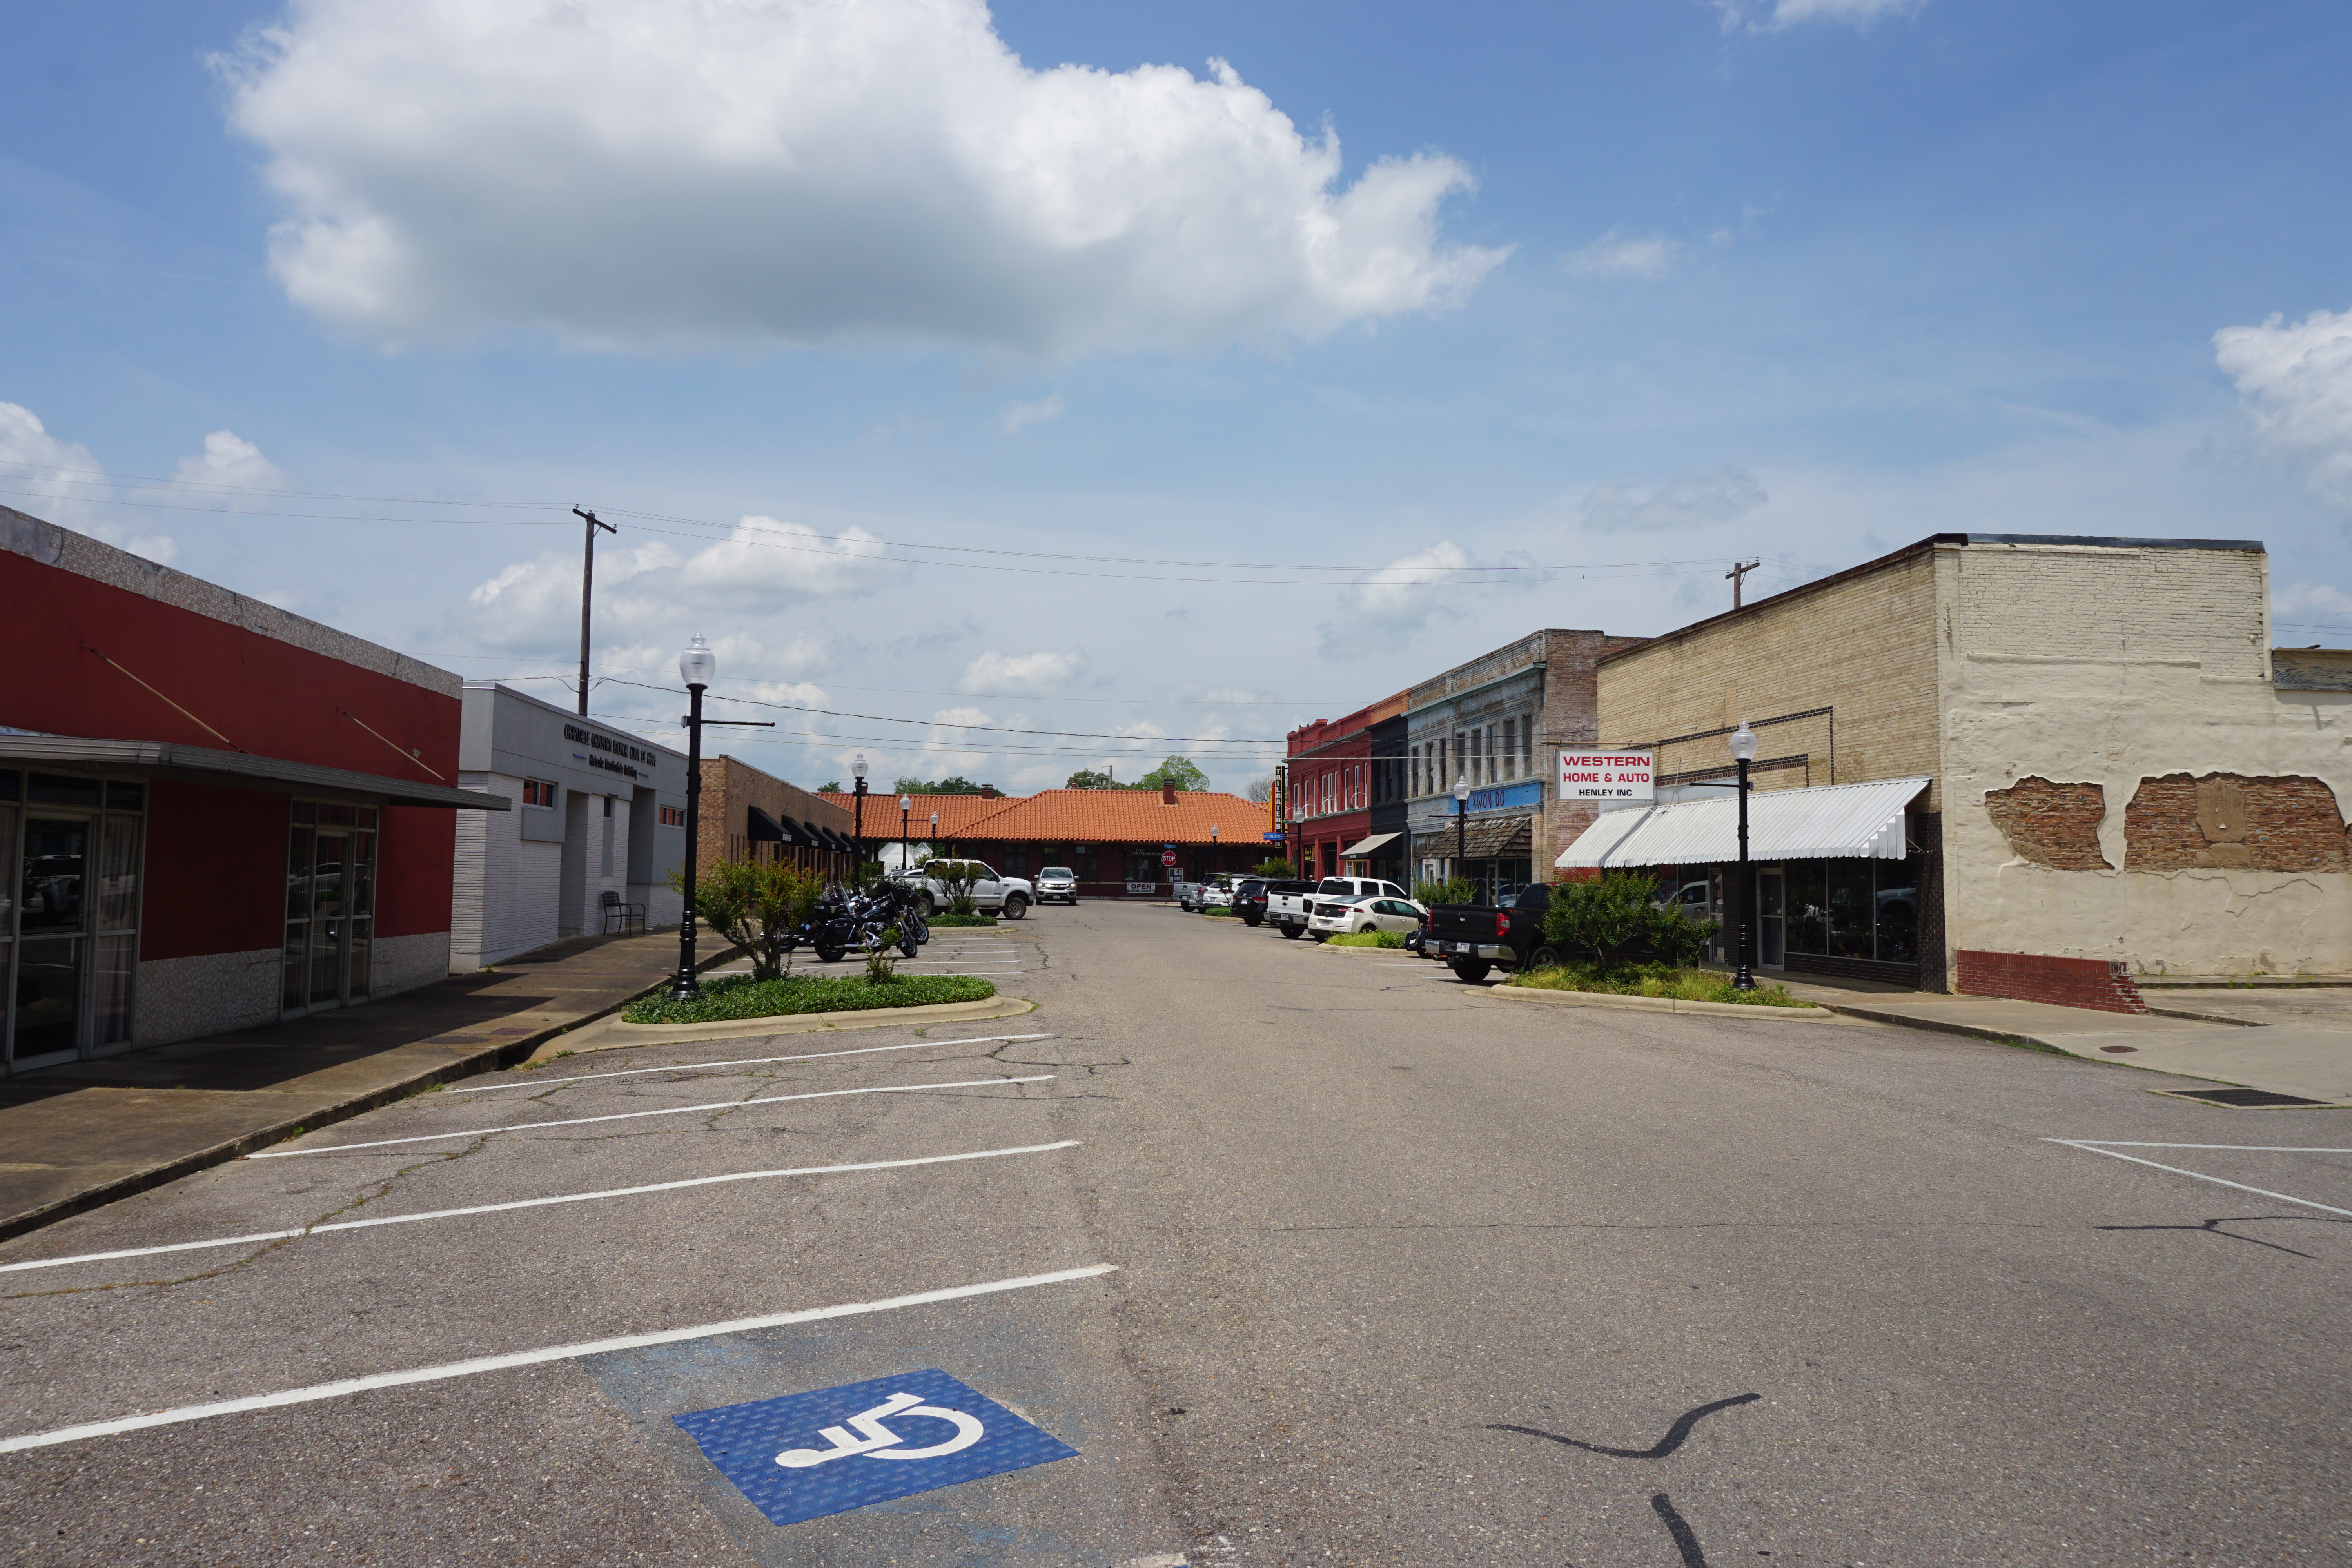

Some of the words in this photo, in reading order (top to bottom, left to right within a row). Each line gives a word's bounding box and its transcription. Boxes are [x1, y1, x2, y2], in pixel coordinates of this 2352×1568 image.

[564, 724, 590, 745] CHARITABLE
[591, 733, 612, 752] CHRISTIAN
[613, 740, 628, 757] MEDICAL
[629, 746, 640, 761] CLINIC
[641, 750, 646, 763] OF
[647, 752, 657, 766] HOPE
[589, 754, 604, 768] Historic
[1563, 756, 1650, 766] WESTERN
[1563, 773, 1599, 782] HOME
[1604, 773, 1612, 782] &
[1618, 773, 1649, 782] AUTO
[1473, 793, 1492, 810] KWON
[1495, 790, 1504, 807] DO
